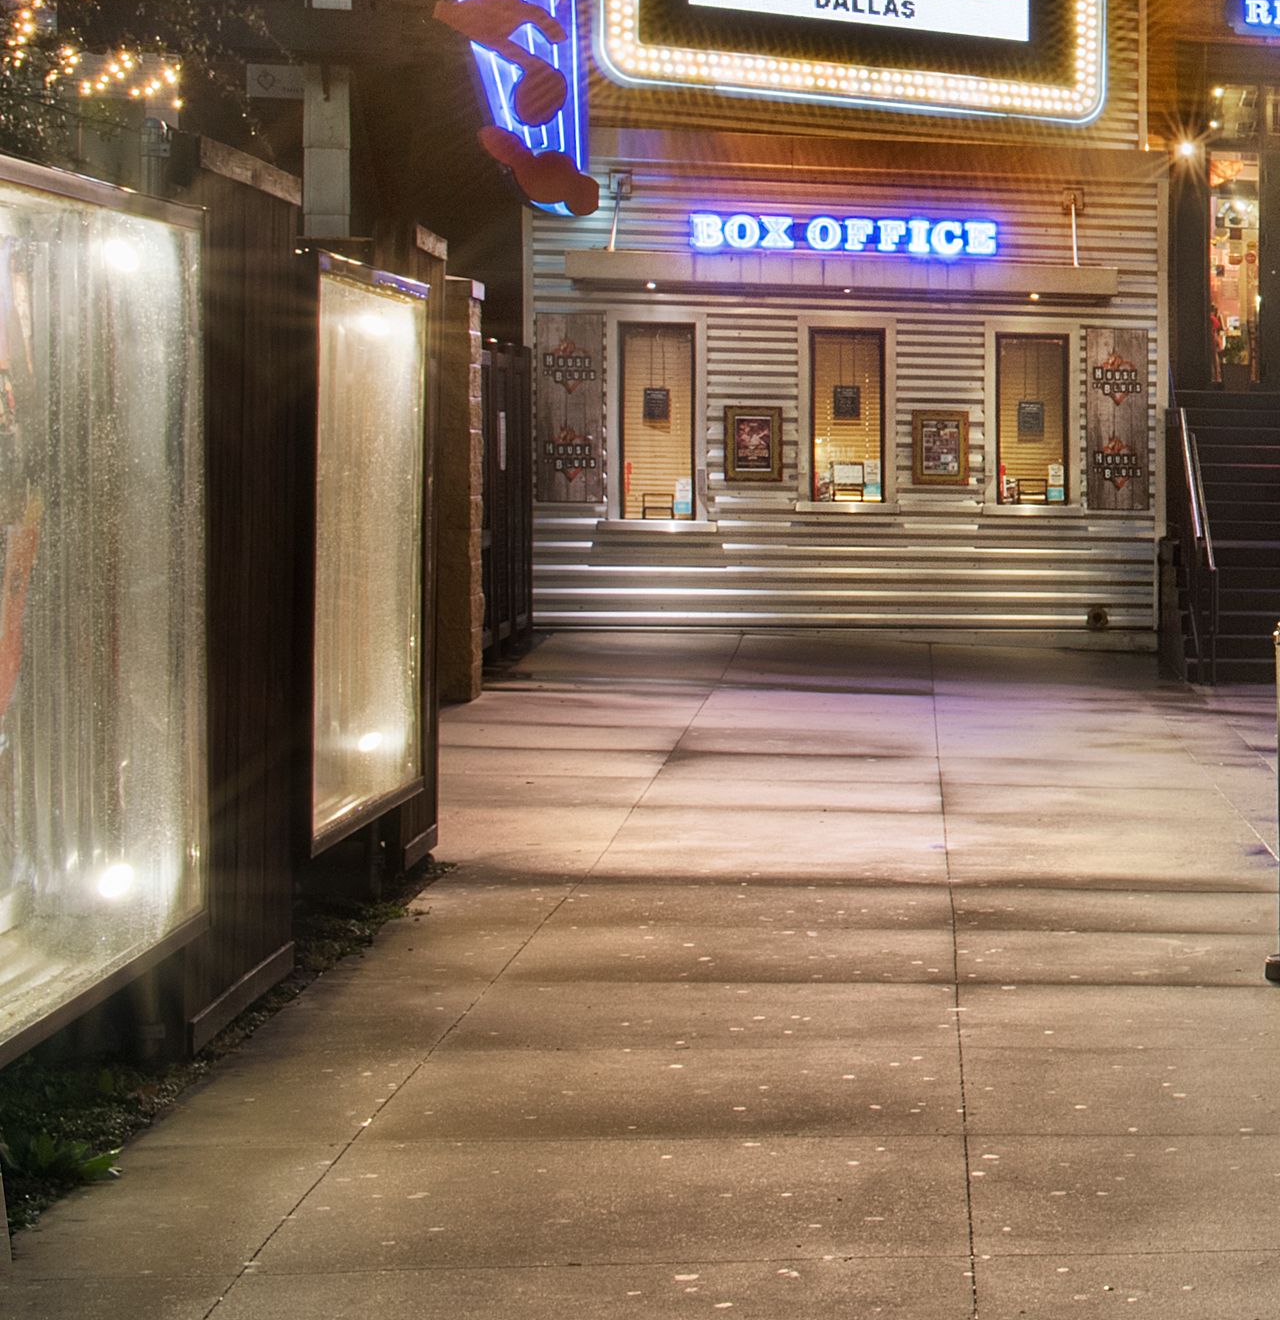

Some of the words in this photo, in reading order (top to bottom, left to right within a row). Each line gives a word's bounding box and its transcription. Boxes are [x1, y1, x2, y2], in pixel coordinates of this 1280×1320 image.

[689, 212, 796, 249] BOX
[806, 216, 998, 256] OFFICE
[545, 354, 590, 368] HOUSE
[1095, 368, 1136, 380] HOUSE
